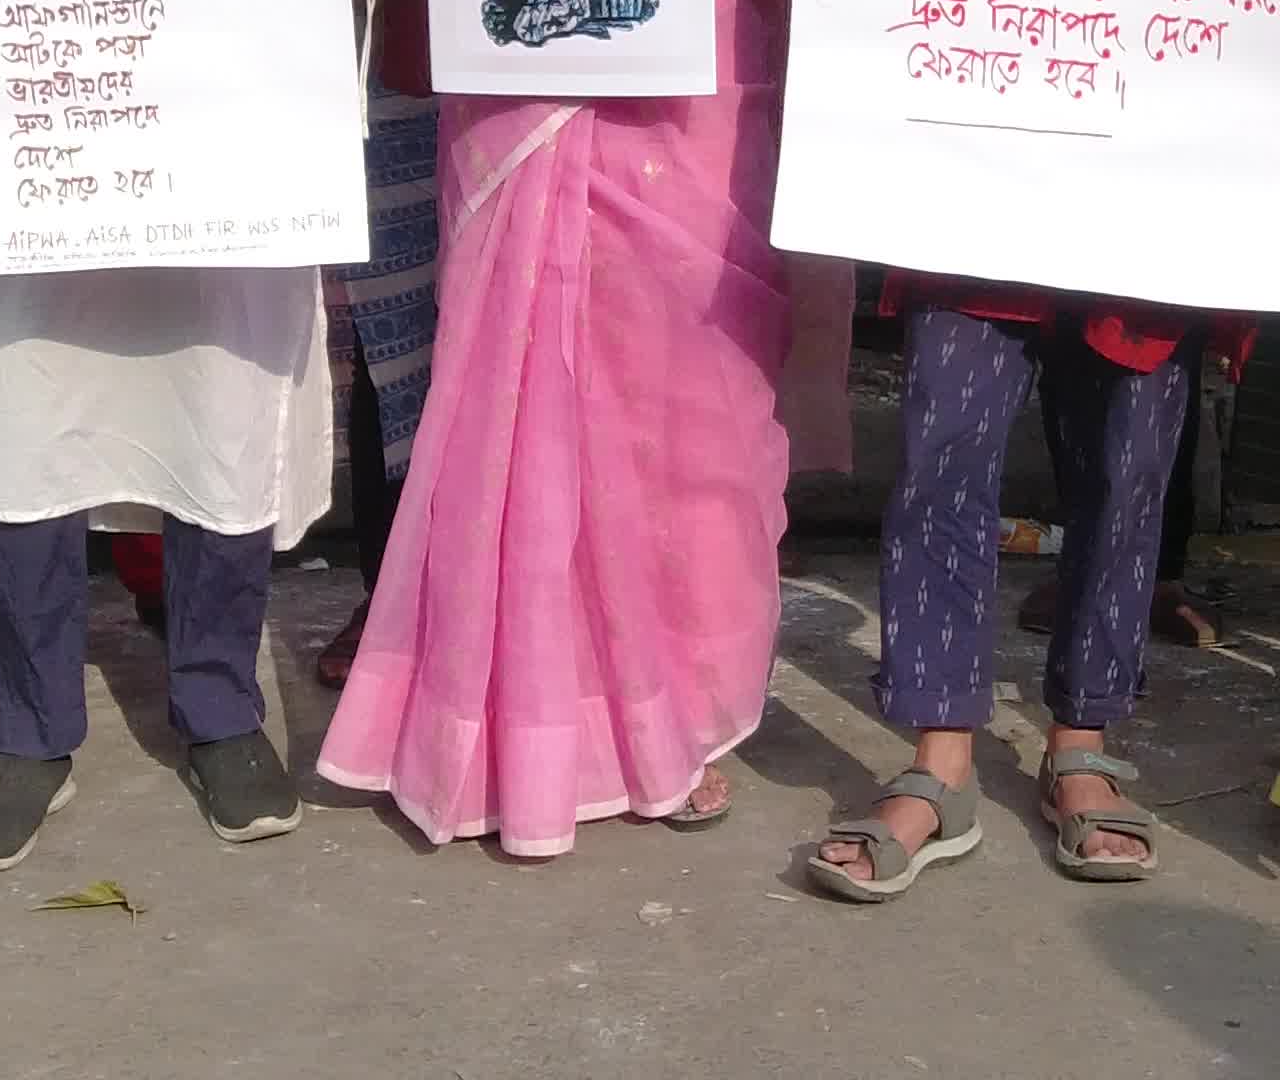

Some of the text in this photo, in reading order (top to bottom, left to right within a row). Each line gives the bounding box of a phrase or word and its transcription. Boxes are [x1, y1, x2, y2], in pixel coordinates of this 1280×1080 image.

[1, 33, 153, 70] আটকে পড়া
[1144, 12, 1230, 63] দেশে
[906, 41, 1024, 96] ফেরাতে
[5, 69, 134, 107] ভারতীয়দের
[8, 103, 161, 140] দ্রুত নিরাপদে
[13, 144, 84, 171] দেশে
[16, 175, 99, 209] ফেরাতে
